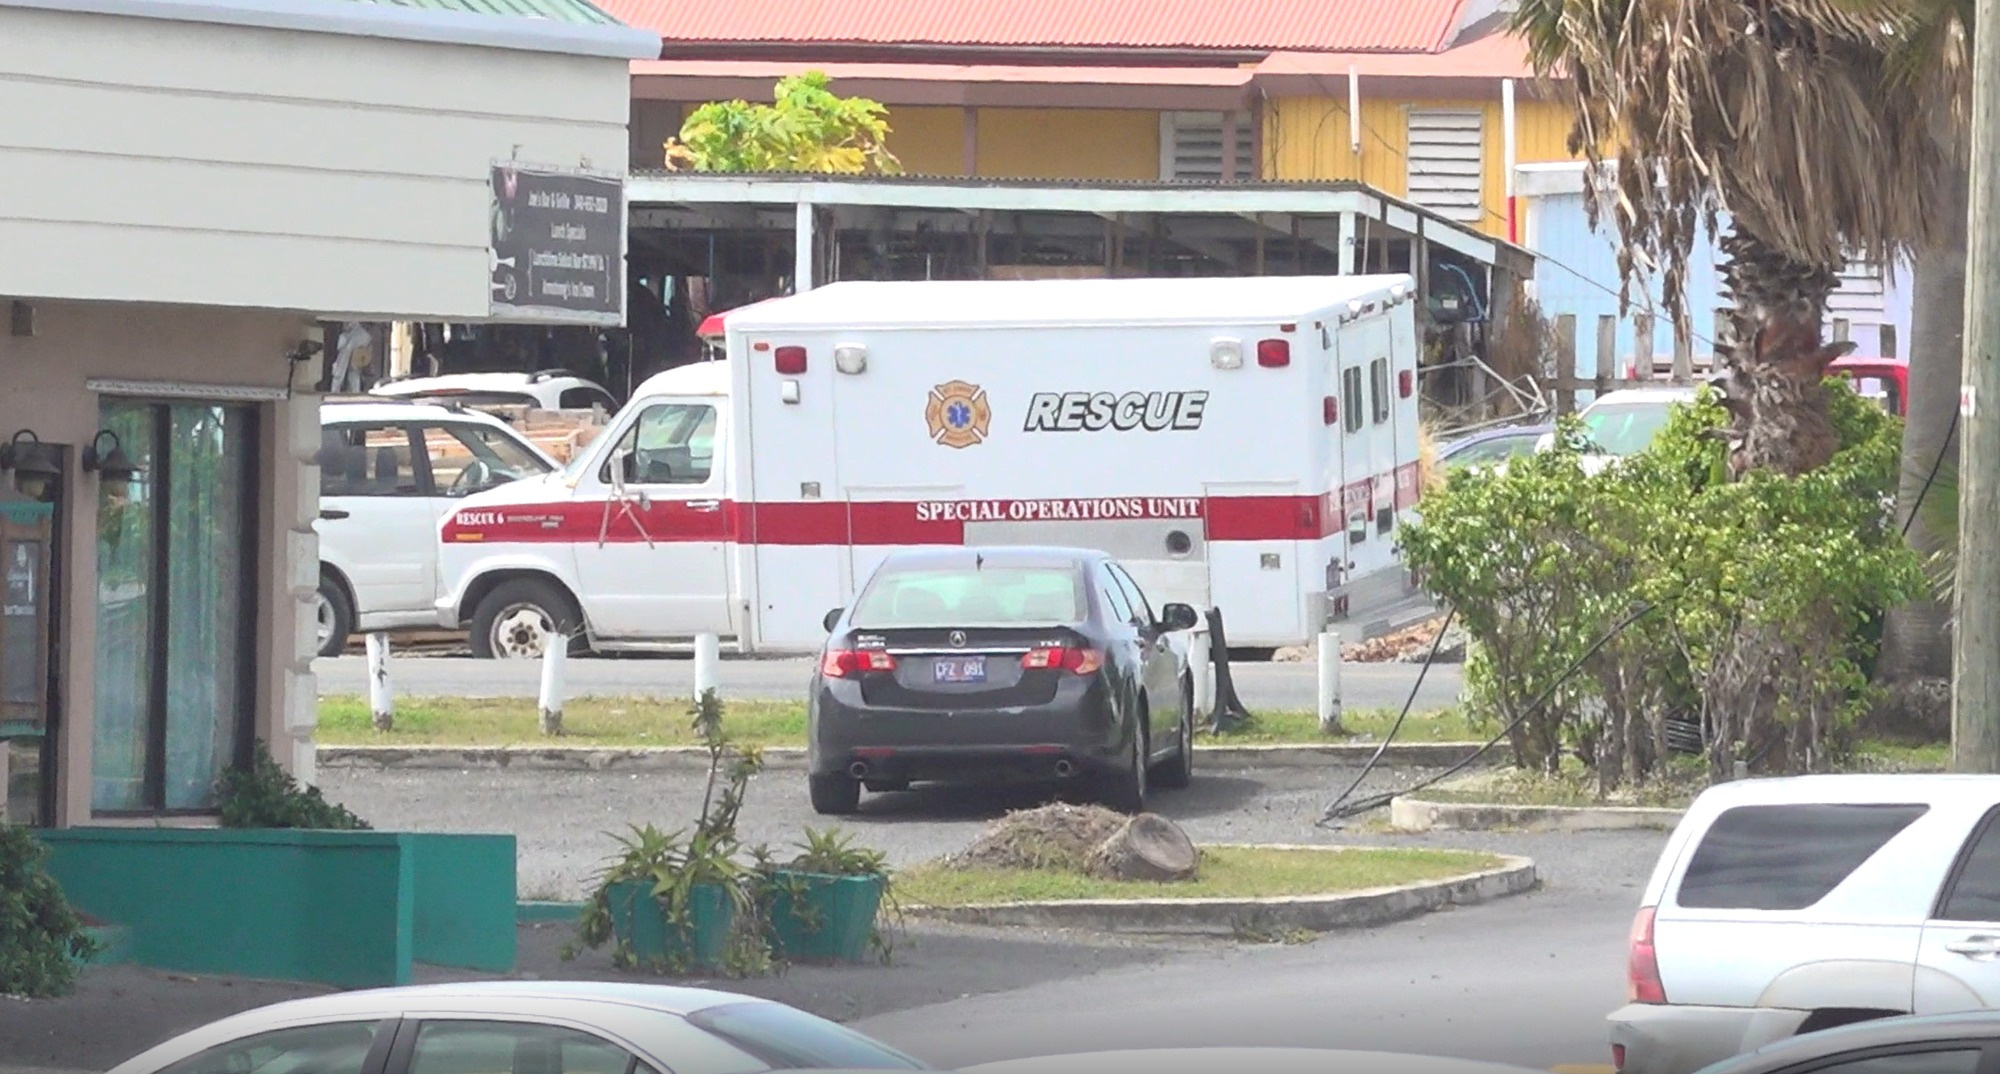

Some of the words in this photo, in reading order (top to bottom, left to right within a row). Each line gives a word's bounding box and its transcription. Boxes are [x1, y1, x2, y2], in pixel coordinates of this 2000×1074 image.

[1023, 390, 1209, 432] RESCUE
[456, 512, 495, 525] RESCUE
[497, 512, 505, 525] 6
[916, 500, 1006, 521] SPECIAL
[1009, 498, 1144, 520] OPERATIONS
[1148, 496, 1201, 517] UNIT
